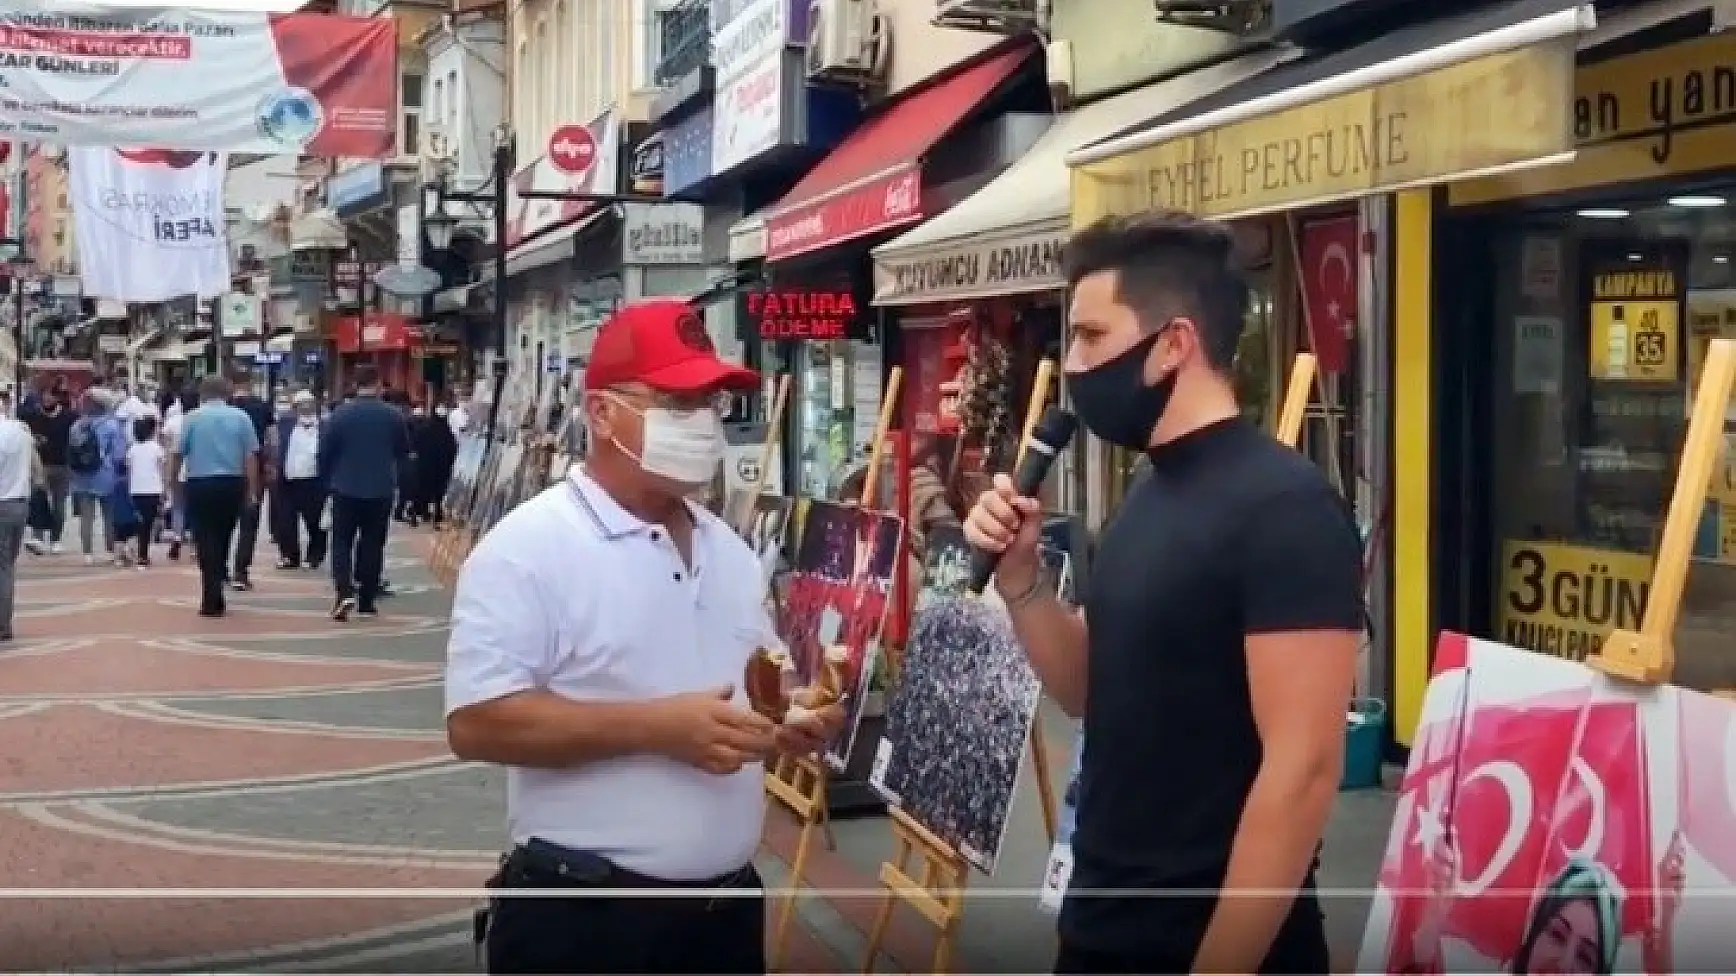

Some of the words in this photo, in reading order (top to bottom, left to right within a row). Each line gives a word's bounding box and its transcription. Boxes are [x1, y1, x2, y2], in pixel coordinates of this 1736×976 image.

[1240, 112, 1408, 194] PERFUME
[1508, 550, 1546, 613] 3
[1552, 564, 1651, 633] GÜN
